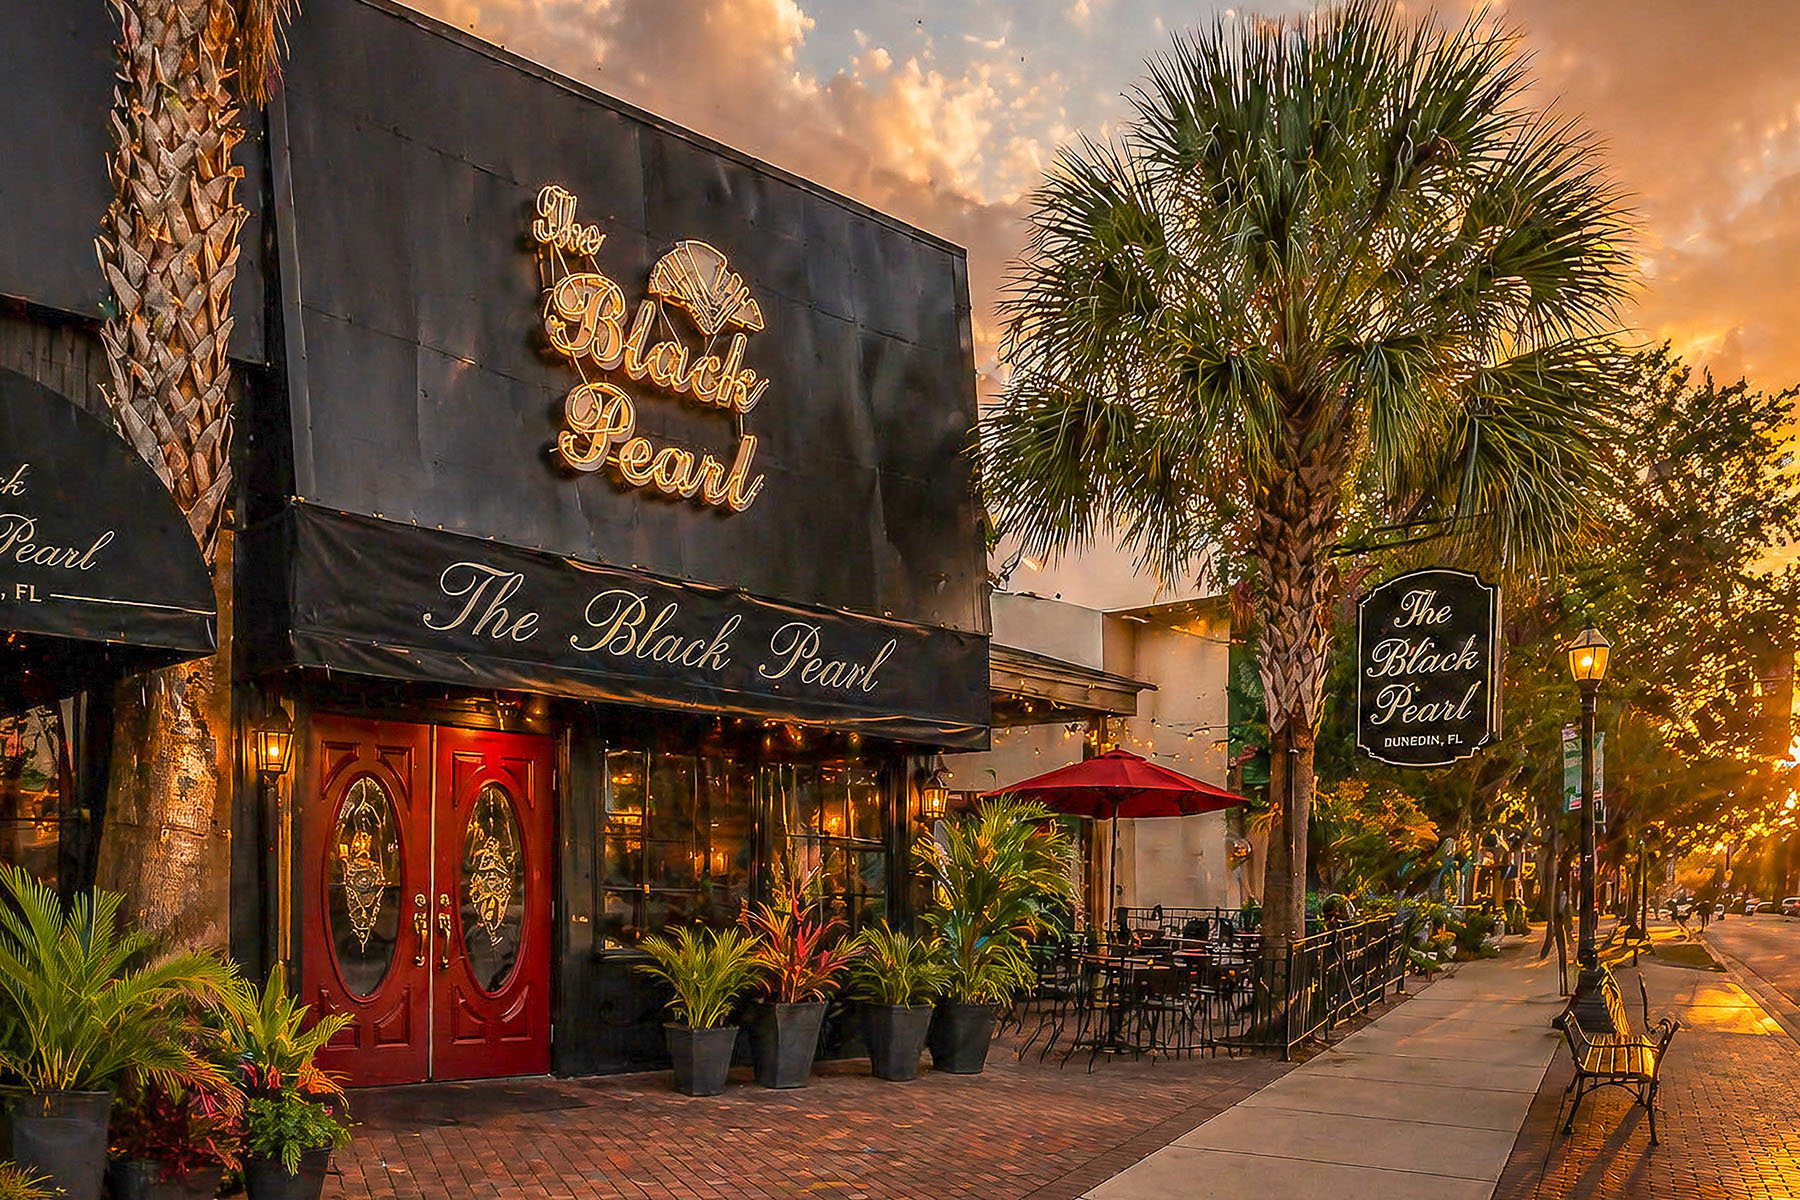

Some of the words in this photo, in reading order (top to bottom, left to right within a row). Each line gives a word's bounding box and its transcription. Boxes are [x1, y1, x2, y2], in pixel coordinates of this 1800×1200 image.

[533, 185, 606, 256] The
[543, 272, 770, 414] Black
[556, 381, 766, 513] Pearl
[0, 513, 115, 570] Pearl
[15, 583, 42, 602] FL
[1393, 589, 1453, 628] The
[422, 561, 540, 642] The
[569, 589, 743, 671] Black
[758, 621, 898, 693] Pearl
[1366, 633, 1479, 678] Black
[1369, 680, 1482, 725] Pearl
[1384, 736, 1445, 748] DUNEDIN,
[1447, 734, 1464, 745] FL
